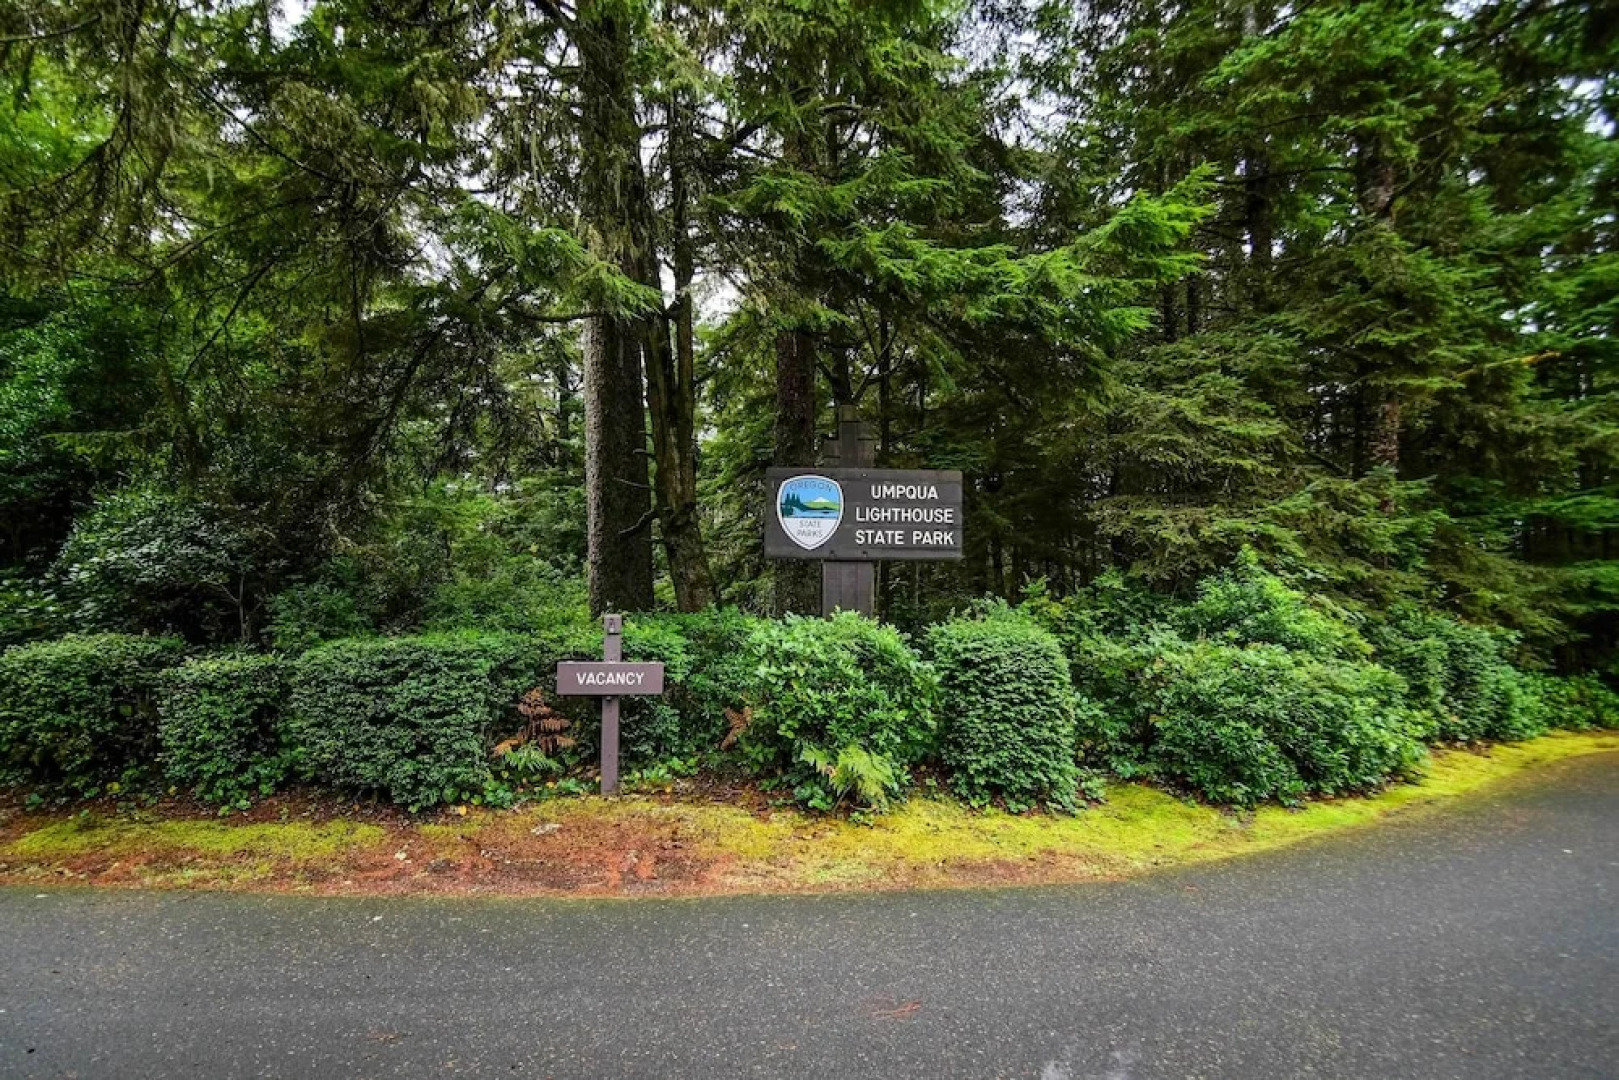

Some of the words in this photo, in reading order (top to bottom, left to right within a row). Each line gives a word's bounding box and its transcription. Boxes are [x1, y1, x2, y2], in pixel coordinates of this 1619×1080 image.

[790, 480, 833, 492] OREGON
[871, 485, 939, 500] UMPQUA
[855, 507, 954, 523] LIGHTHOUSE
[799, 520, 821, 528] STATE
[797, 530, 823, 538] PARKS
[855, 530, 904, 545] STATE
[912, 531, 954, 545] PARK
[576, 671, 645, 686] VACANCY
